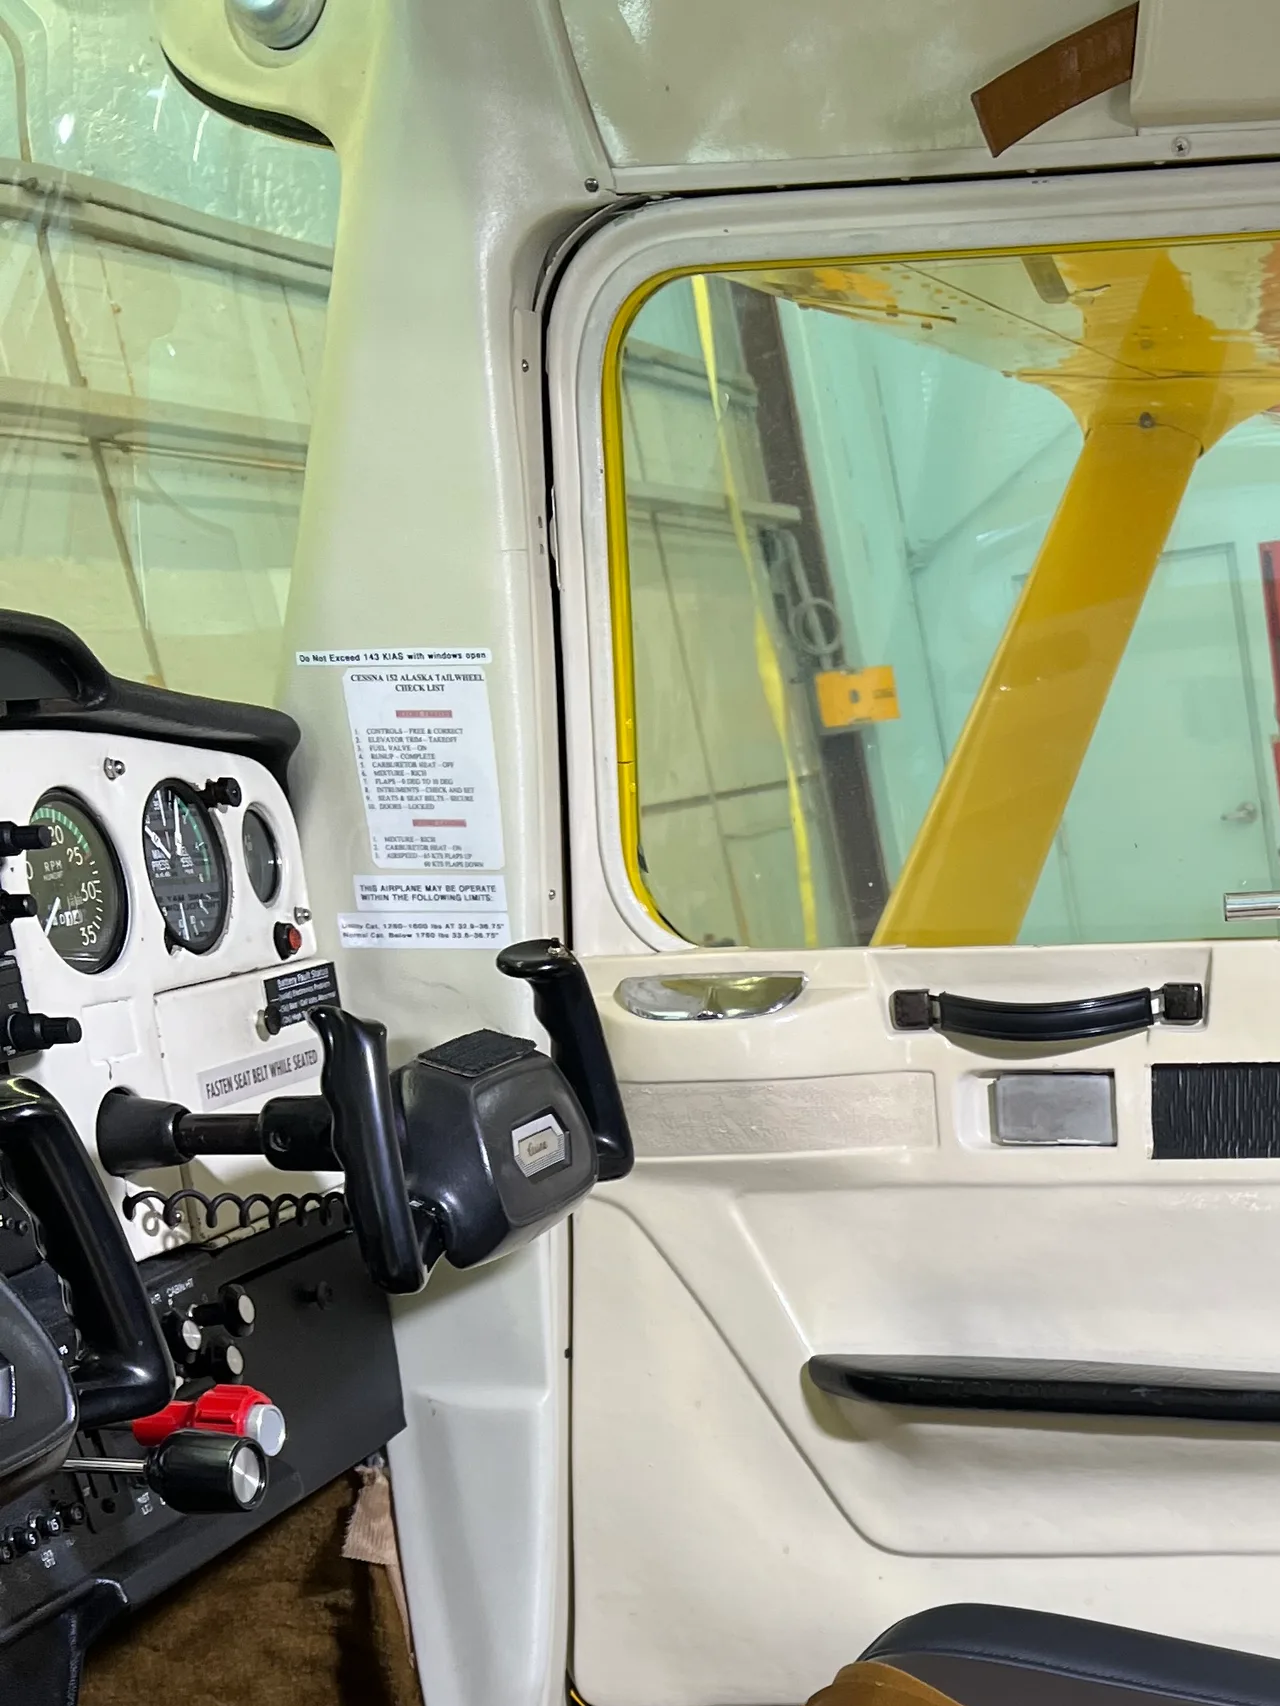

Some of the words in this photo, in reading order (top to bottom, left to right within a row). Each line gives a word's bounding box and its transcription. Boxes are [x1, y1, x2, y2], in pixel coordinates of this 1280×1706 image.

[299, 654, 310, 663] Do
[312, 654, 328, 663] Not
[330, 653, 361, 662] Exceed
[364, 653, 380, 661] 143
[383, 652, 404, 661] KIAS
[407, 652, 425, 660] with
[428, 652, 462, 660] windows
[466, 652, 487, 661] open
[350, 674, 385, 682] CESSNA
[386, 674, 399, 682] 152
[435, 673, 485, 681] TAILWHEEL
[395, 684, 426, 692] CHECK
[43, 859, 63, 872] RPM
[360, 884, 378, 892] THIS
[380, 884, 422, 892] AIRPLANE
[425, 884, 442, 892] MAY
[445, 884, 456, 892] BE
[458, 884, 496, 892] OPERATE
[79, 925, 97, 946] 35
[205, 1076, 234, 1100] FASTEN
[233, 1070, 251, 1090] SEAT
[251, 1064, 269, 1084] BELT
[268, 1057, 293, 1078] WHILE
[292, 1049, 319, 1071] SEATED
